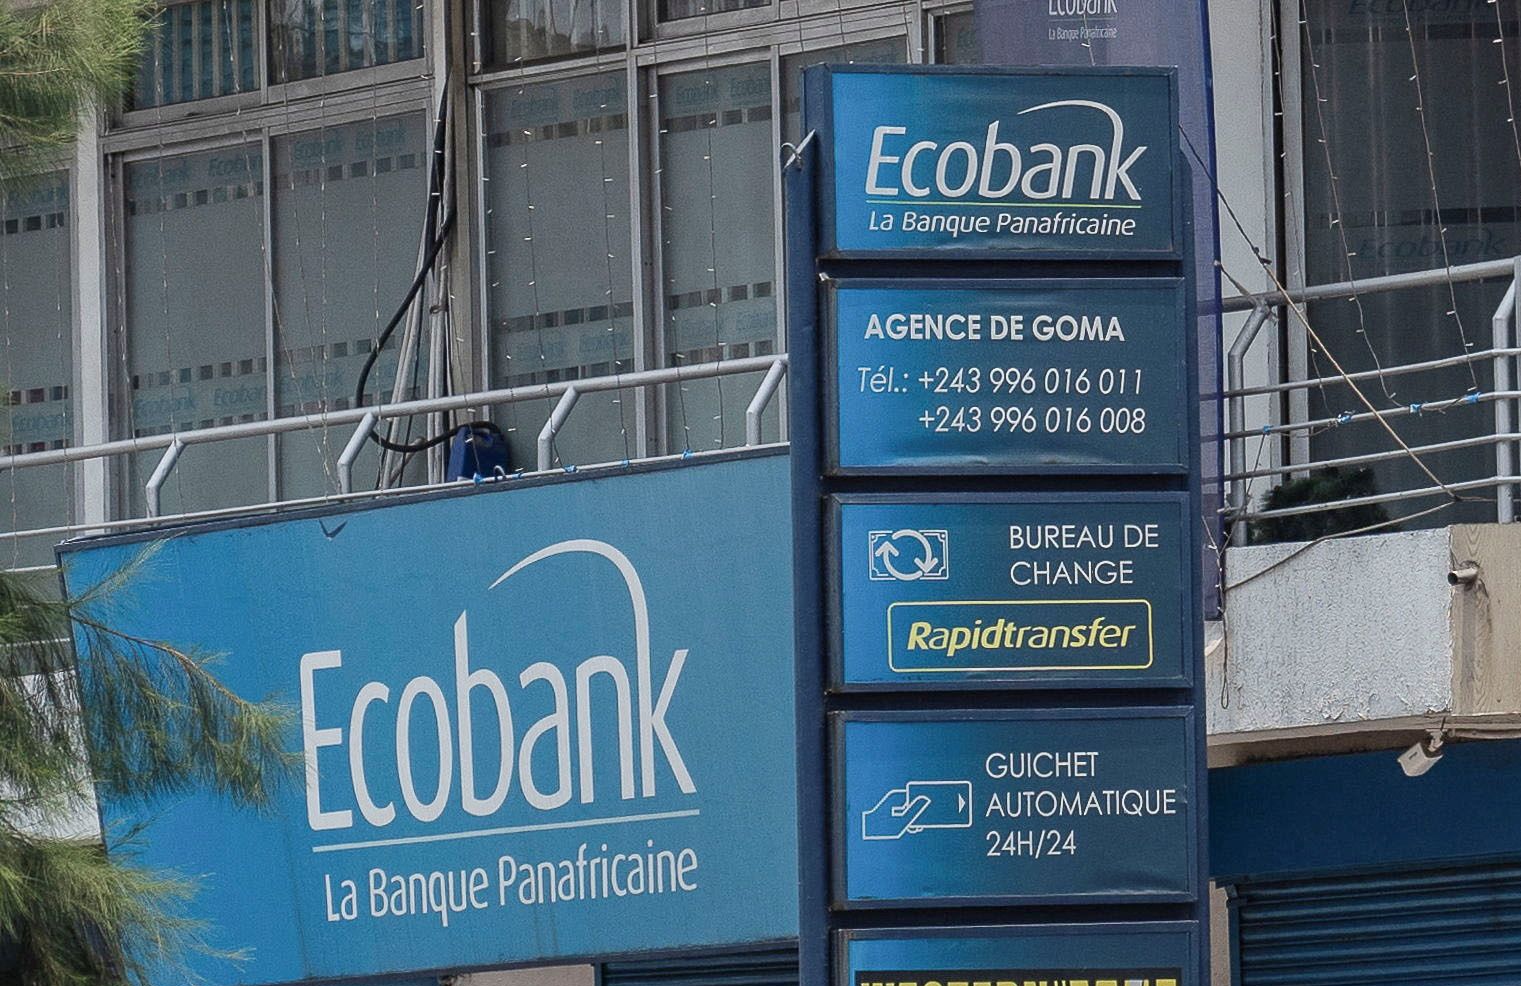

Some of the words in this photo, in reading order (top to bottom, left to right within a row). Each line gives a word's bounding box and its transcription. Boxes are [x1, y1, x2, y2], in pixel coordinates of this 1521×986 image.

[864, 100, 1148, 201] Ecobank
[869, 211, 894, 232] La
[902, 211, 990, 238] Banque
[996, 212, 1137, 236] Panafricaine
[864, 314, 981, 341] AGENCE
[990, 315, 1023, 341] DE
[1032, 316, 1126, 342] GOMA
[857, 366, 909, 394] Tél.:
[918, 368, 981, 394] +243
[990, 368, 1037, 395] 996
[1045, 369, 1093, 395] 016
[1100, 369, 1142, 395] 011
[919, 407, 981, 433] +243
[990, 407, 1037, 433] 996
[1045, 407, 1094, 433] 016
[1100, 408, 1146, 434] 008
[1009, 524, 1115, 550] BUREAU
[1124, 524, 1159, 548] DE
[1010, 560, 1134, 586] CHANGE
[907, 616, 1137, 657] Rapidtransfer
[300, 538, 697, 832] Ecobank
[985, 752, 1099, 779] GUICHET
[985, 789, 1177, 818] AUTOMATIQUE
[986, 829, 1076, 859] 24H/24
[324, 873, 358, 921] La
[369, 867, 488, 927] Banque
[499, 839, 698, 906] Panafricaine
